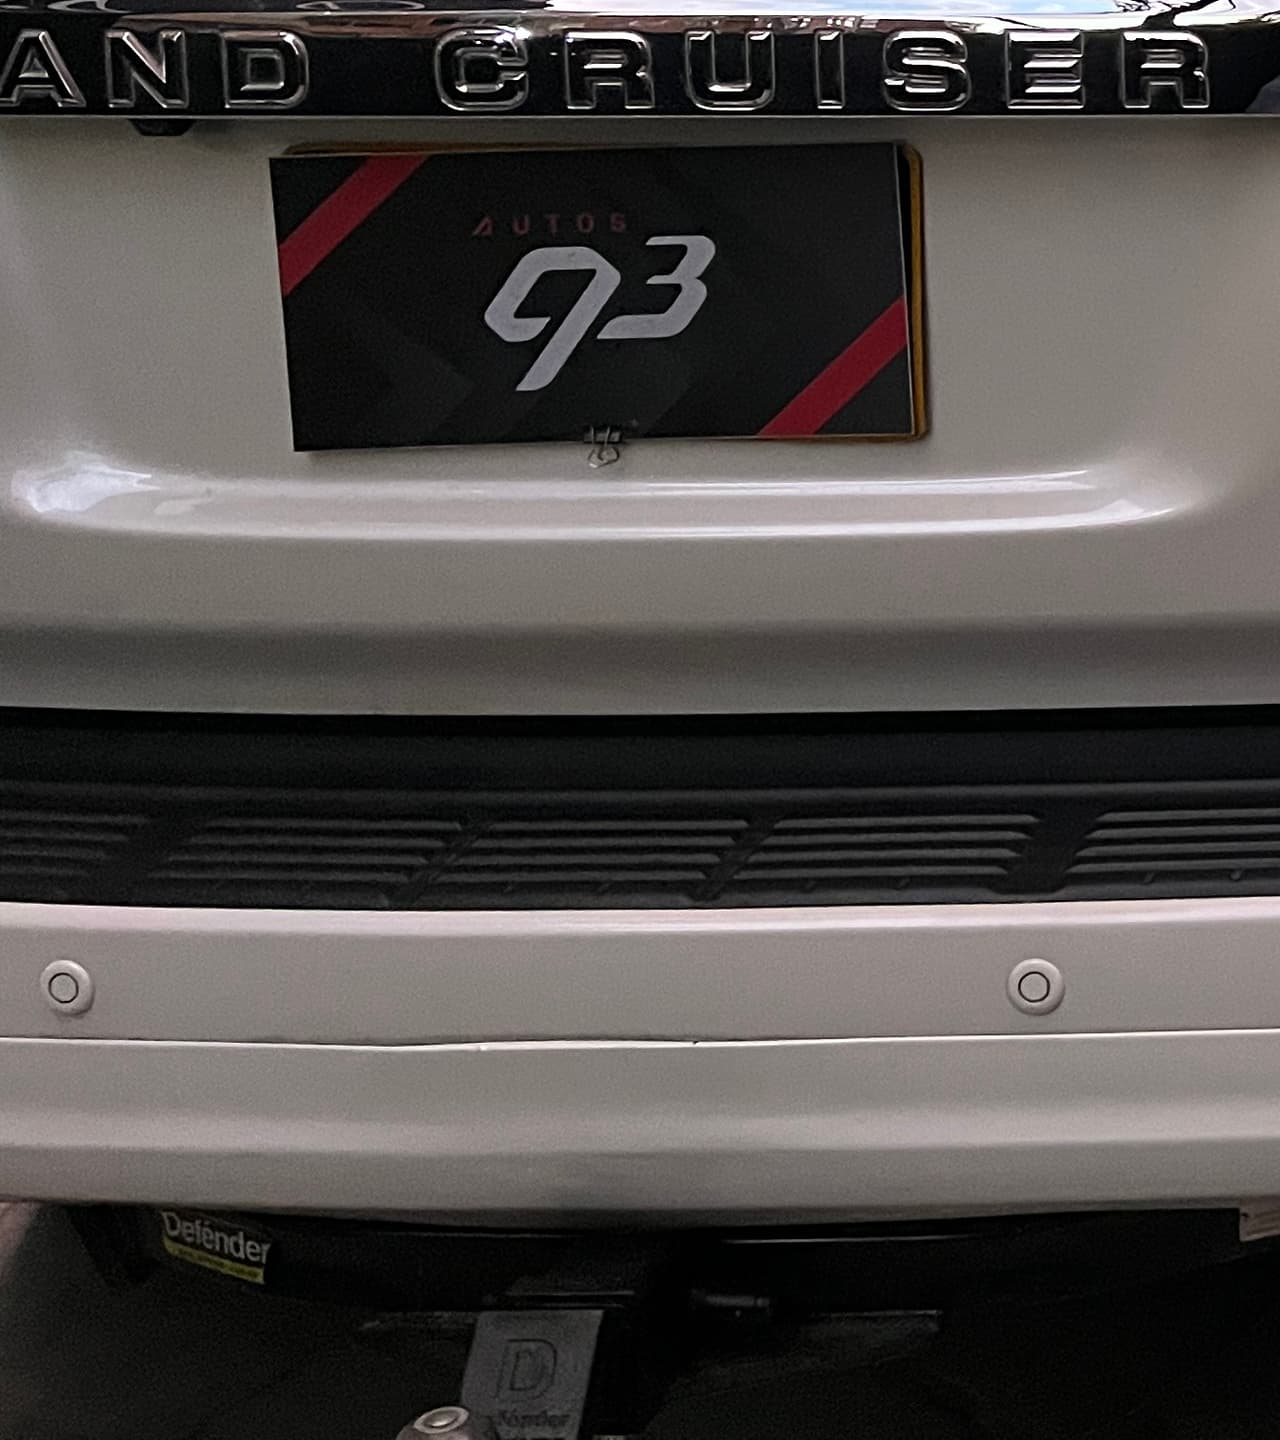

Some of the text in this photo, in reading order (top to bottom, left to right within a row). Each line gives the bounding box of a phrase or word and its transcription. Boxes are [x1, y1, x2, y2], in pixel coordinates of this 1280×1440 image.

[436, 25, 1211, 112] CRUISER
[472, 212, 628, 236] AUTOS
[484, 234, 717, 392] 93
